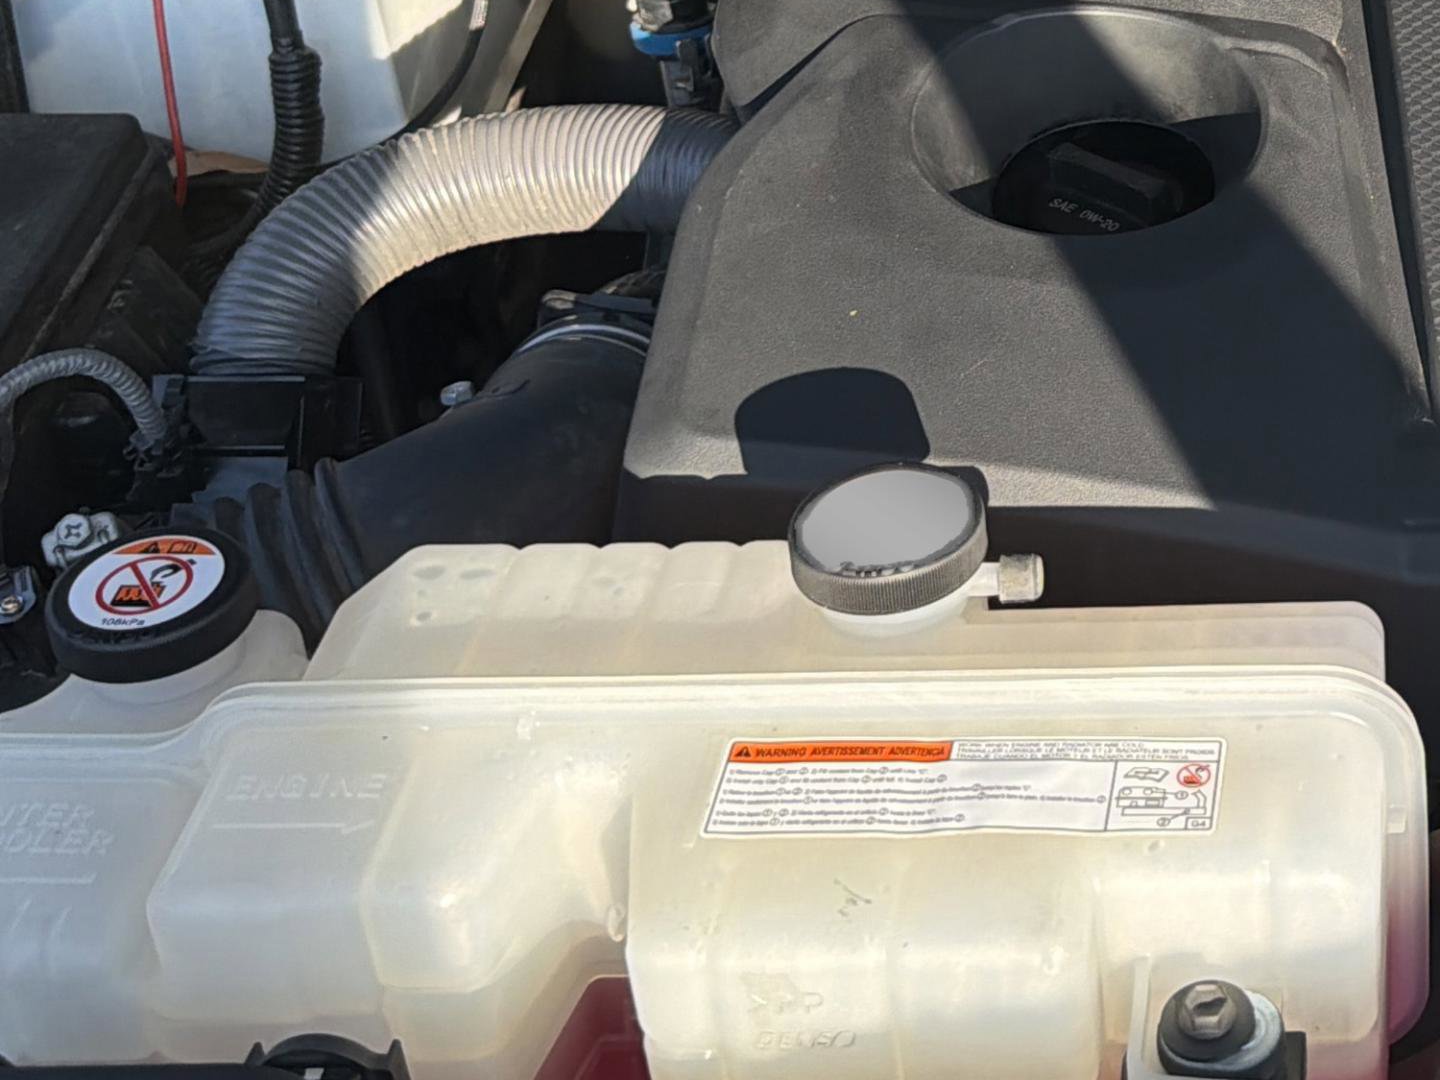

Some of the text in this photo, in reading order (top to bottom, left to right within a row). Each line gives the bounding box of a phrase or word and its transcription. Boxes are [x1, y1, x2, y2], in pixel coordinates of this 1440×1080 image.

[1048, 197, 1122, 233] SAE 0W-20
[755, 746, 807, 758] WARNING
[810, 745, 886, 757] AVERTISSEMENT
[224, 773, 387, 800] ENGINE
